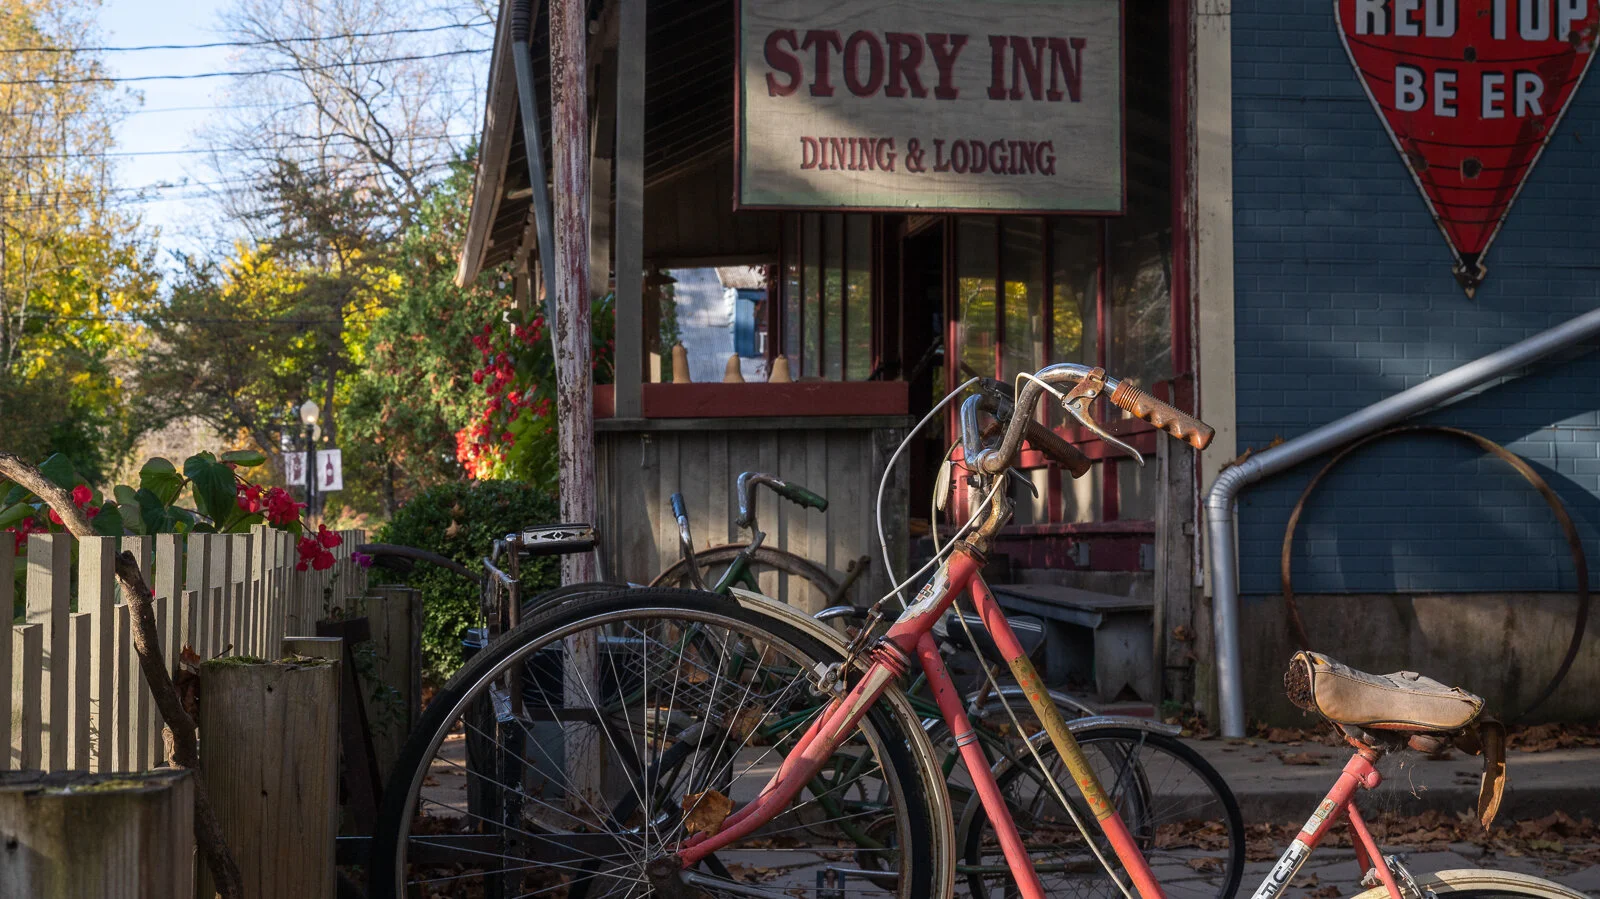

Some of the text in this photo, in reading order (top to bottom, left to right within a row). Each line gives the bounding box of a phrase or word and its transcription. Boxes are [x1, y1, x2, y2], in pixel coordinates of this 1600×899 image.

[763, 29, 1087, 103] STORY INN
[1395, 64, 1545, 119] BEER
[800, 136, 1056, 175] DINING & LODGING
